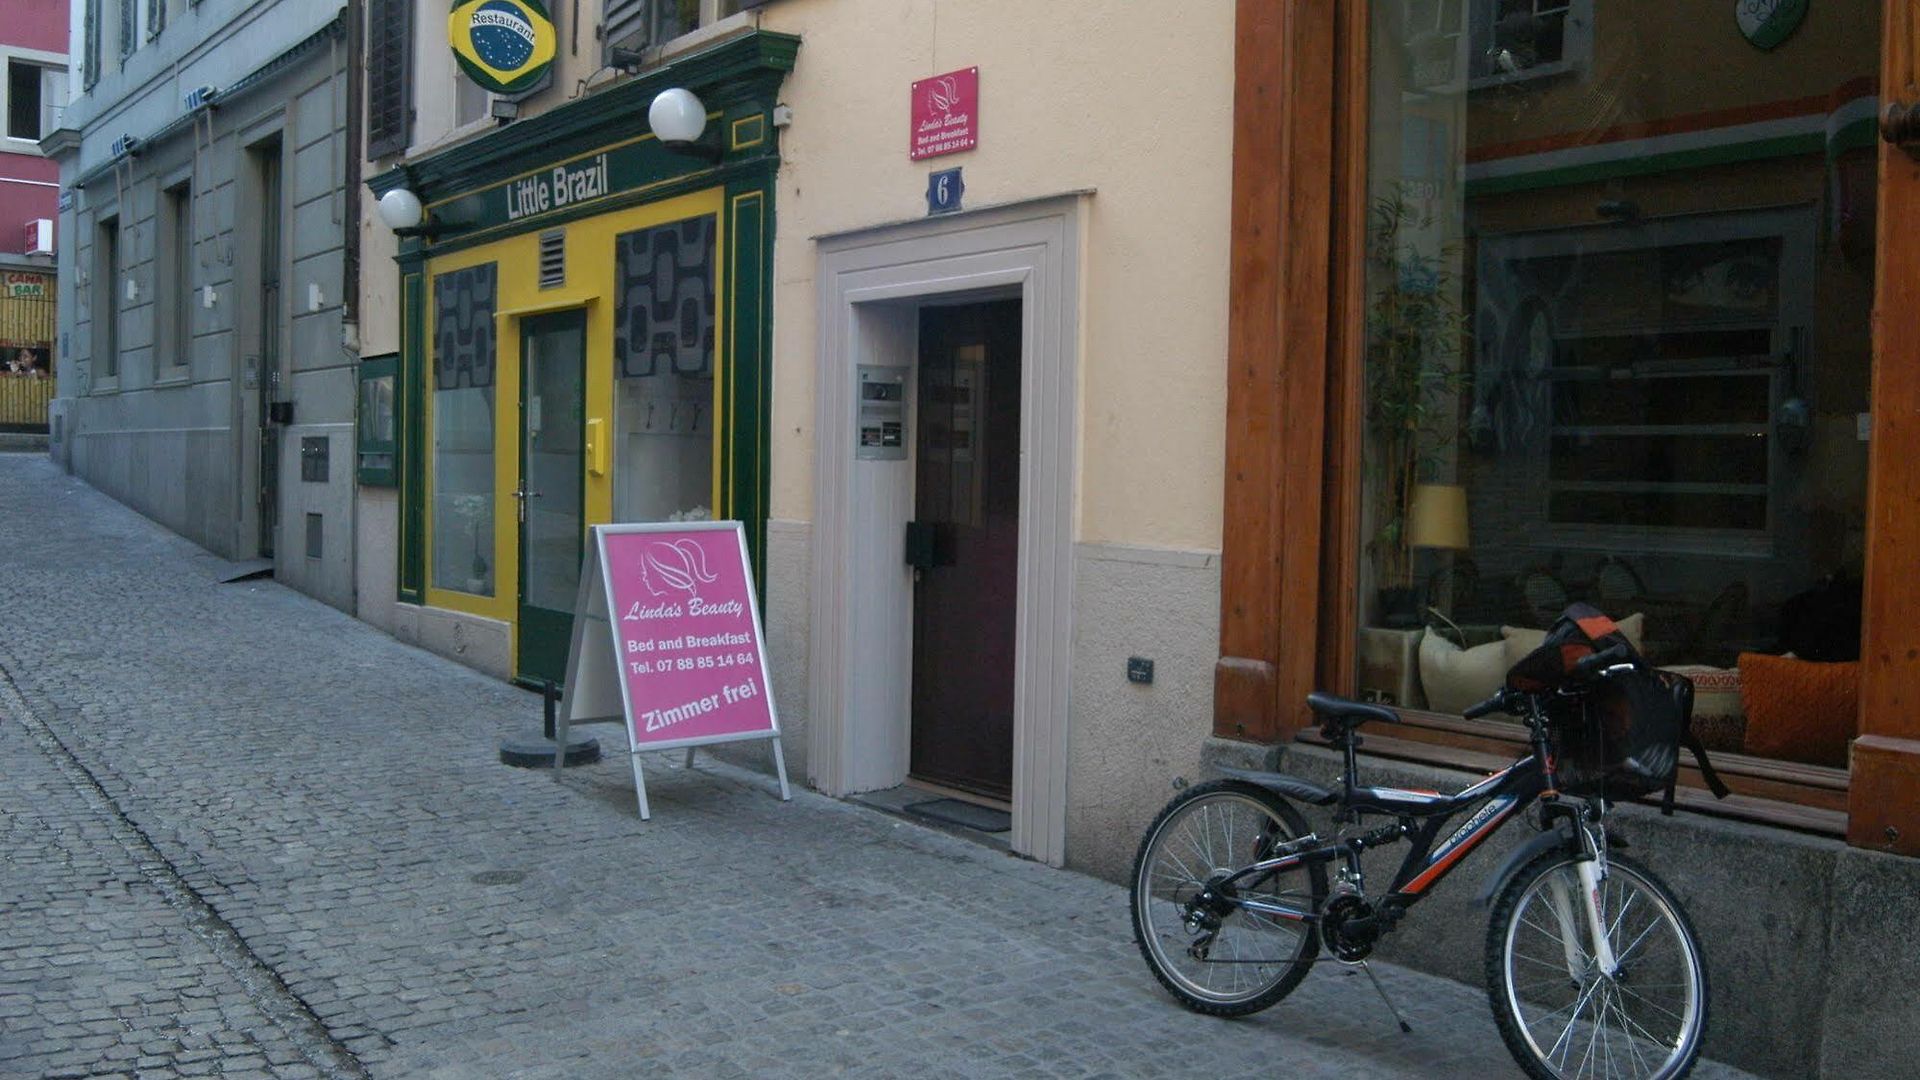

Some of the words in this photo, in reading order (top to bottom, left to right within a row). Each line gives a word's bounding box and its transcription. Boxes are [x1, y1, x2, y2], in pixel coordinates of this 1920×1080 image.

[472, 13, 535, 41] Restaurant
[918, 120, 942, 132] Linda's
[944, 113, 968, 126] Beauty
[917, 135, 929, 145] Bed
[929, 133, 940, 143] and
[940, 127, 969, 140] Breakfast
[507, 175, 549, 219] Little
[553, 153, 608, 206] Brazil
[937, 175, 949, 205] 6
[14, 285, 41, 295] BAR
[623, 600, 683, 621] Linda's
[687, 597, 744, 619] Beauty
[627, 639, 655, 653] Bed
[658, 636, 683, 651] and
[685, 631, 751, 648] Breakfast
[630, 661, 654, 675] Tel.
[656, 659, 673, 672] 07
[677, 658, 694, 671] 88
[697, 655, 714, 669] 85
[717, 653, 735, 667] 14
[737, 652, 753, 665] 64
[641, 693, 720, 733] Zimmer
[722, 677, 758, 704] frei
